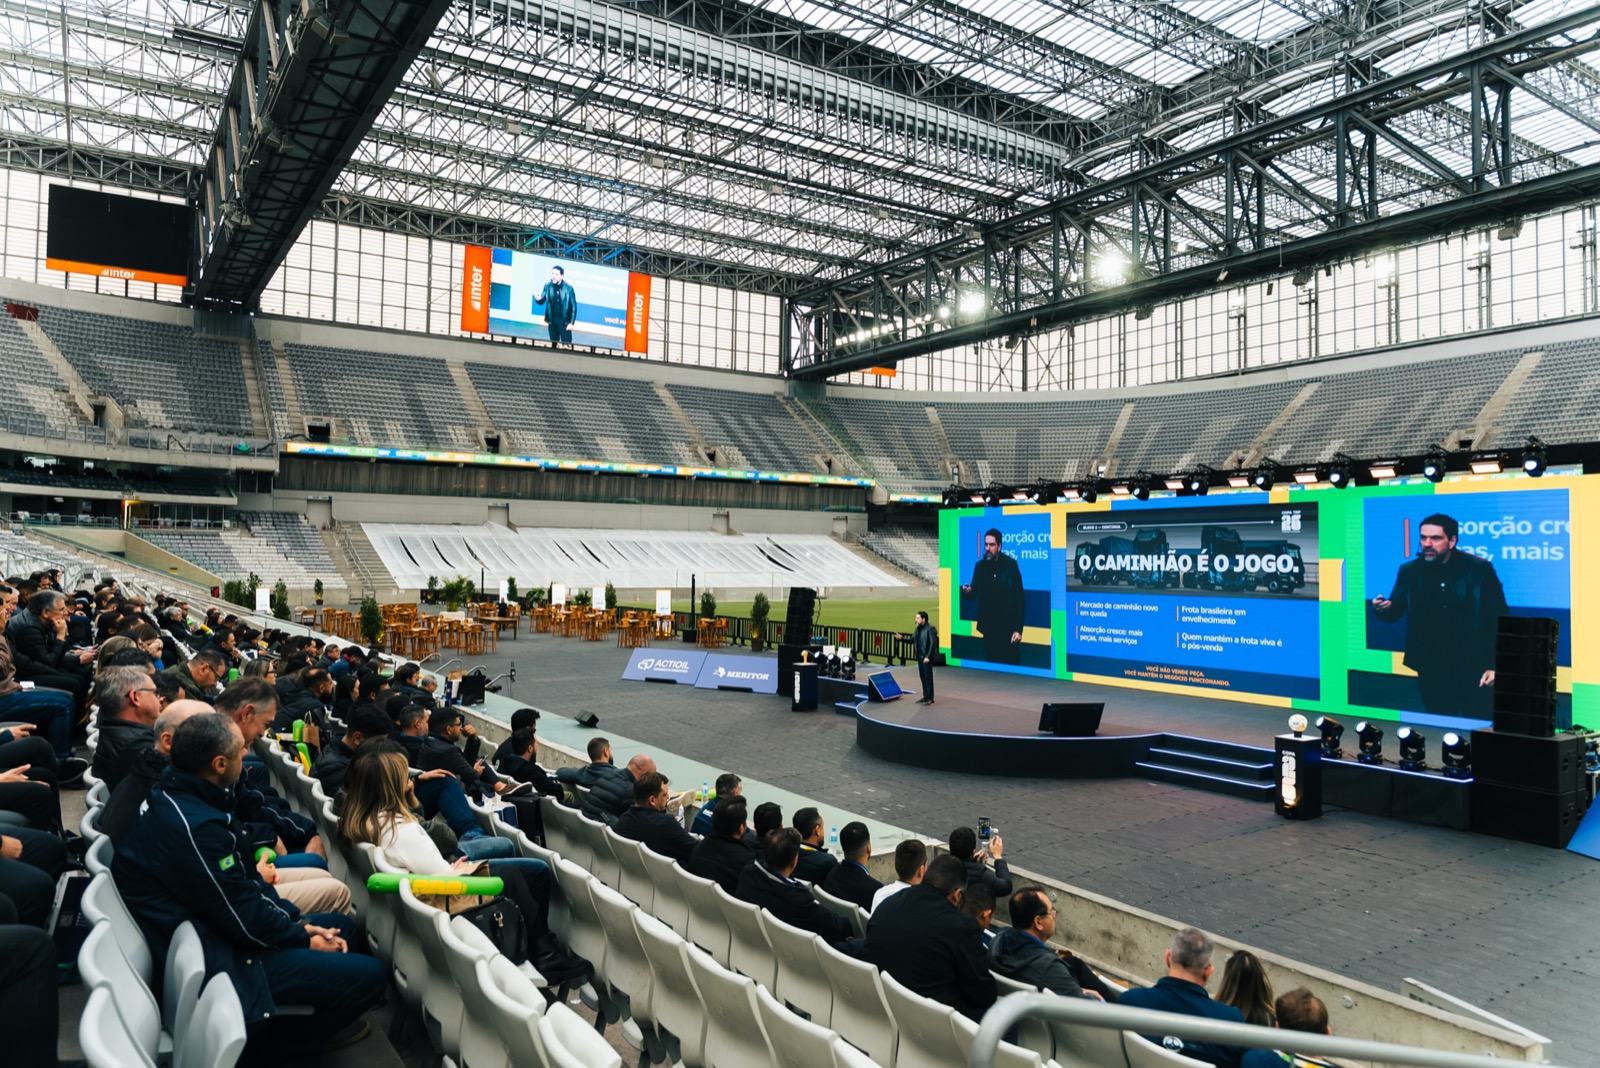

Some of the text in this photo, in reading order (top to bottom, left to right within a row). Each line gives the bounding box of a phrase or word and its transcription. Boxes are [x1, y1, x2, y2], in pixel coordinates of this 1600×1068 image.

[109, 269, 136, 279] inter
[470, 265, 483, 301] inter
[632, 292, 644, 323] inter
[1021, 547, 1049, 560] mais
[1502, 542, 1564, 561] mais
[1079, 548, 1300, 573] O CAMINHÃO É O JOGO.
[1080, 601, 1104, 609] Mercado
[1104, 602, 1112, 610] de
[1113, 602, 1142, 611] caminhão
[1181, 605, 1200, 614] Frota
[1200, 606, 1233, 616] brasileira
[1090, 610, 1108, 618] queda
[1181, 615, 1237, 625] envelhecimento
[1080, 625, 1143, 637] Absorção cresce: mais
[1098, 635, 1112, 643] mais
[1113, 637, 1138, 646] serviços
[1181, 632, 1203, 641] Quem
[1203, 634, 1233, 643] mantém
[1240, 636, 1259, 646] frota
[1260, 638, 1276, 647] viva
[1276, 638, 1283, 648] é
[1187, 642, 1224, 653] pós-venda
[654, 659, 690, 670] ACTIOIL
[726, 670, 770, 681] MERITOR
